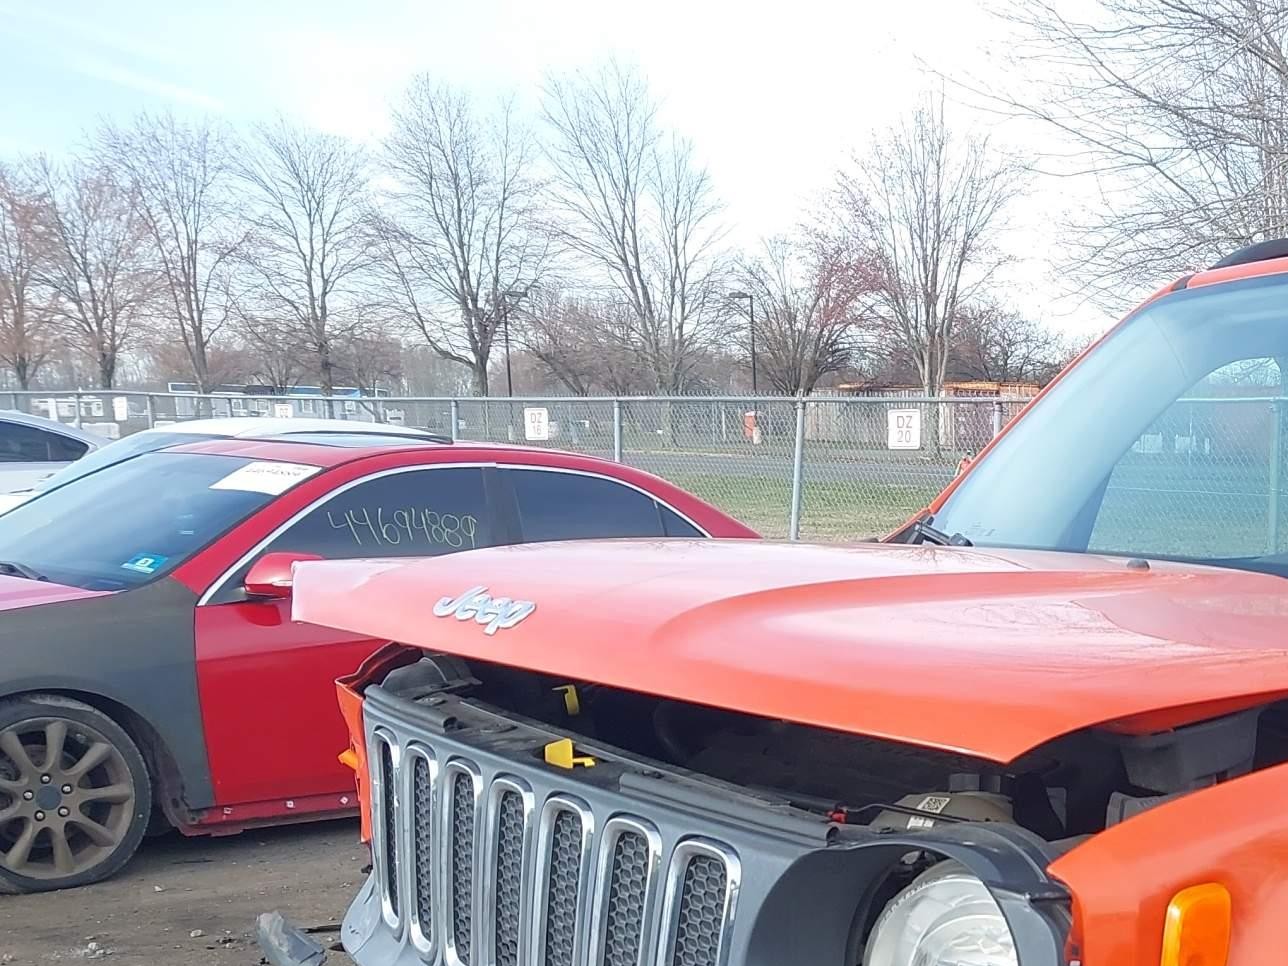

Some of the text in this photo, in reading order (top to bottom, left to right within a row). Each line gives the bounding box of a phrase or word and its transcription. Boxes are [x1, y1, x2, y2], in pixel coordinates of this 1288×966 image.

[896, 415, 913, 429] DZ
[896, 429, 911, 443] 20
[327, 507, 477, 549] 44694889
[432, 585, 537, 636] Jeep
